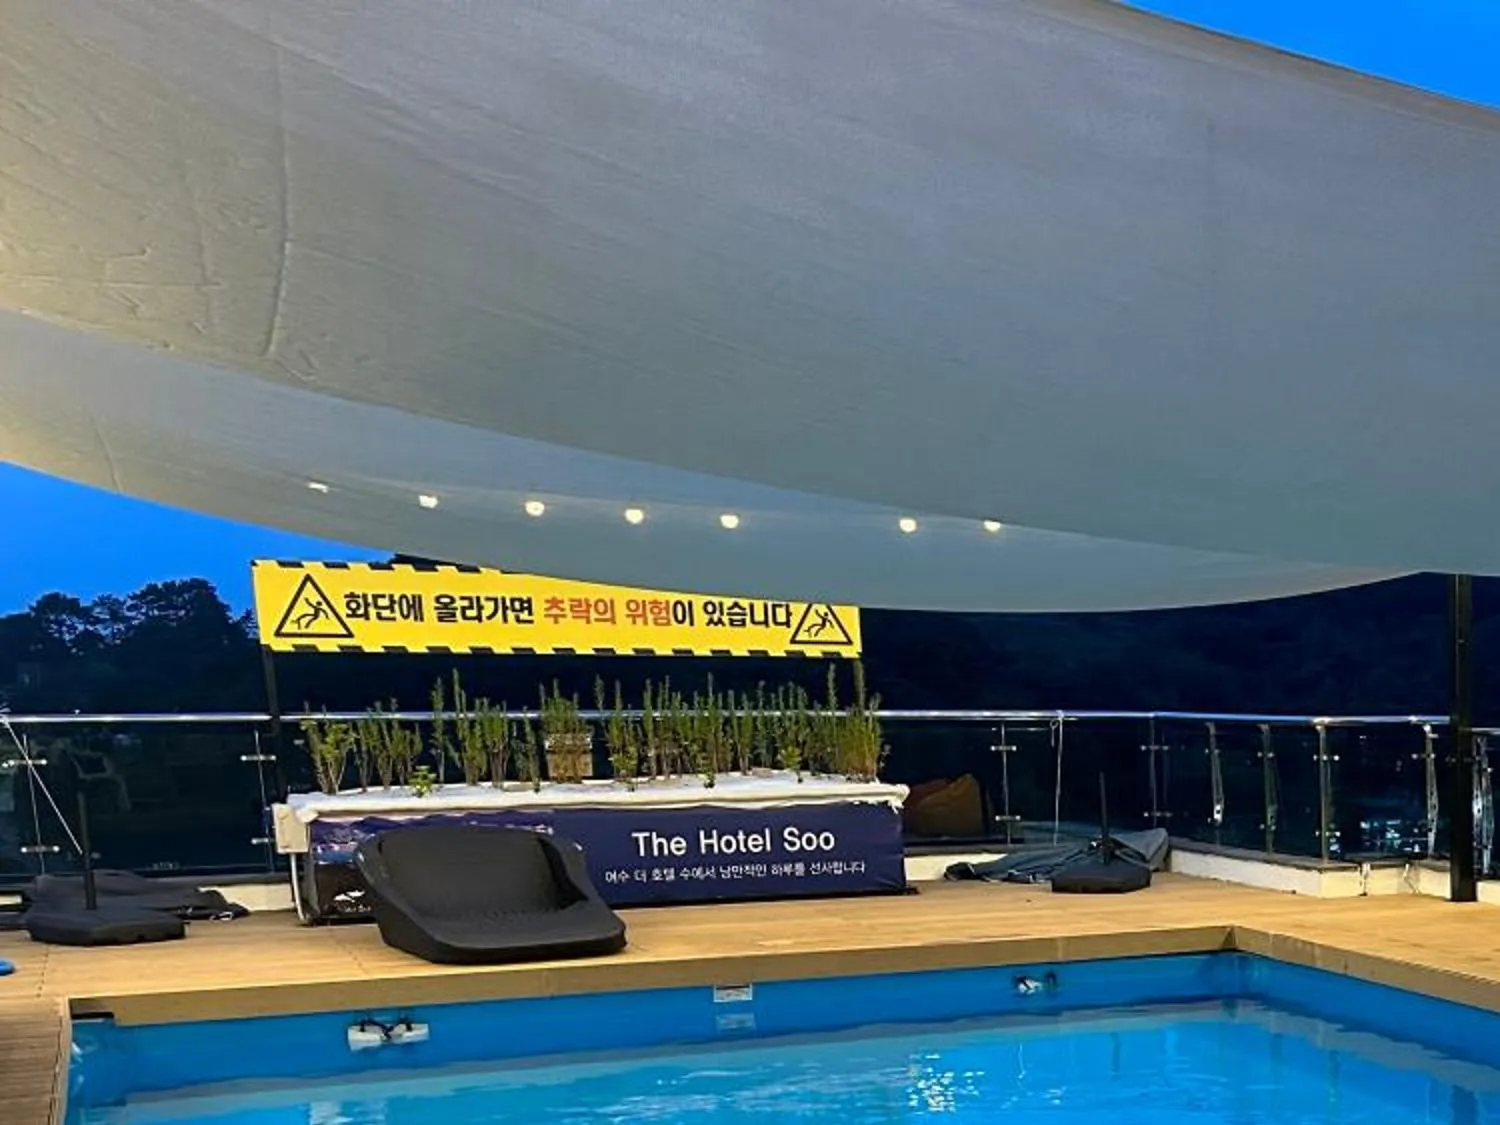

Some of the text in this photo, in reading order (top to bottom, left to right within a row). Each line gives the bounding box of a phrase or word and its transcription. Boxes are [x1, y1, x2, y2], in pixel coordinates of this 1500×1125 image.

[343, 591, 793, 628] 화단에 올라가면 추락의 위험이 있습니다
[632, 826, 836, 857] The Hotel Soo
[652, 867, 675, 882] 호텔
[680, 865, 717, 881] 수에서
[719, 863, 767, 880] 낭만적인
[771, 861, 806, 877] 하루를
[809, 859, 866, 876] 선사합니다
